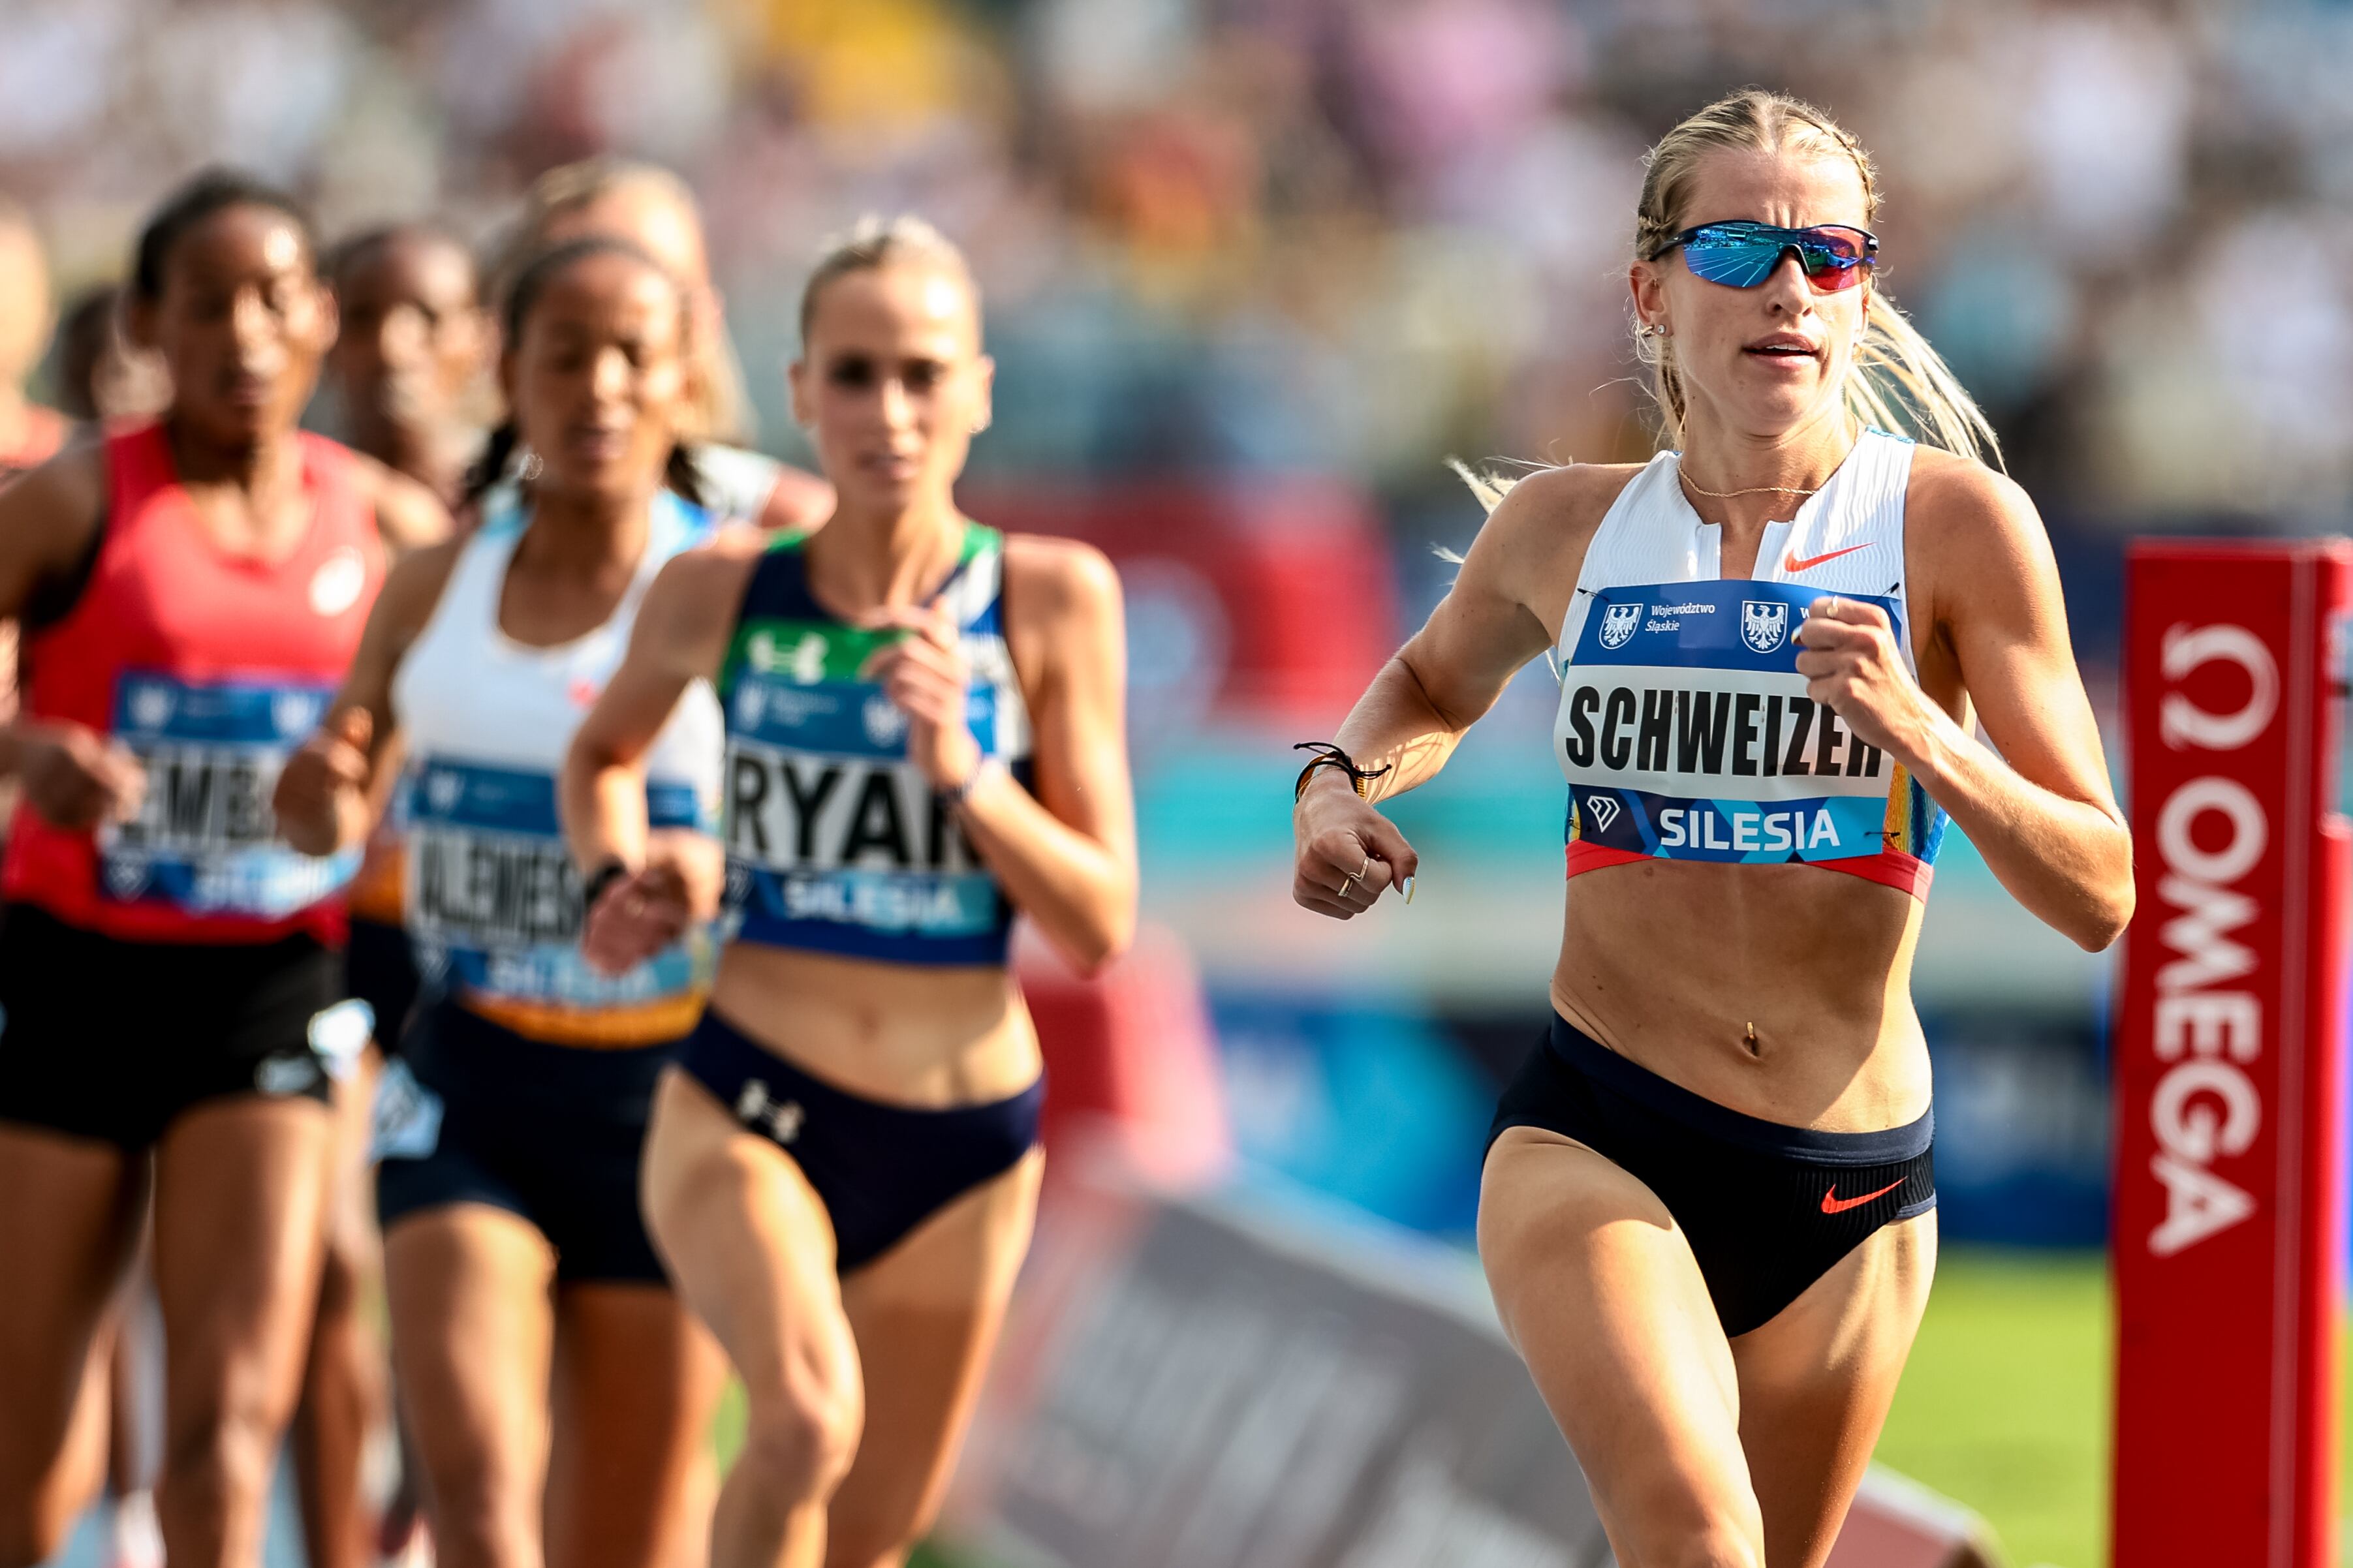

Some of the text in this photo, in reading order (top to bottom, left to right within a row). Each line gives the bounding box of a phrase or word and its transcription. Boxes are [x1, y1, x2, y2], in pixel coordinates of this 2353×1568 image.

[1651, 602, 1715, 618] Województwo
[1645, 620, 1680, 634] Śląskie
[1659, 808, 1841, 851] SILESIA
[2147, 776, 2269, 1257] OMEGA
